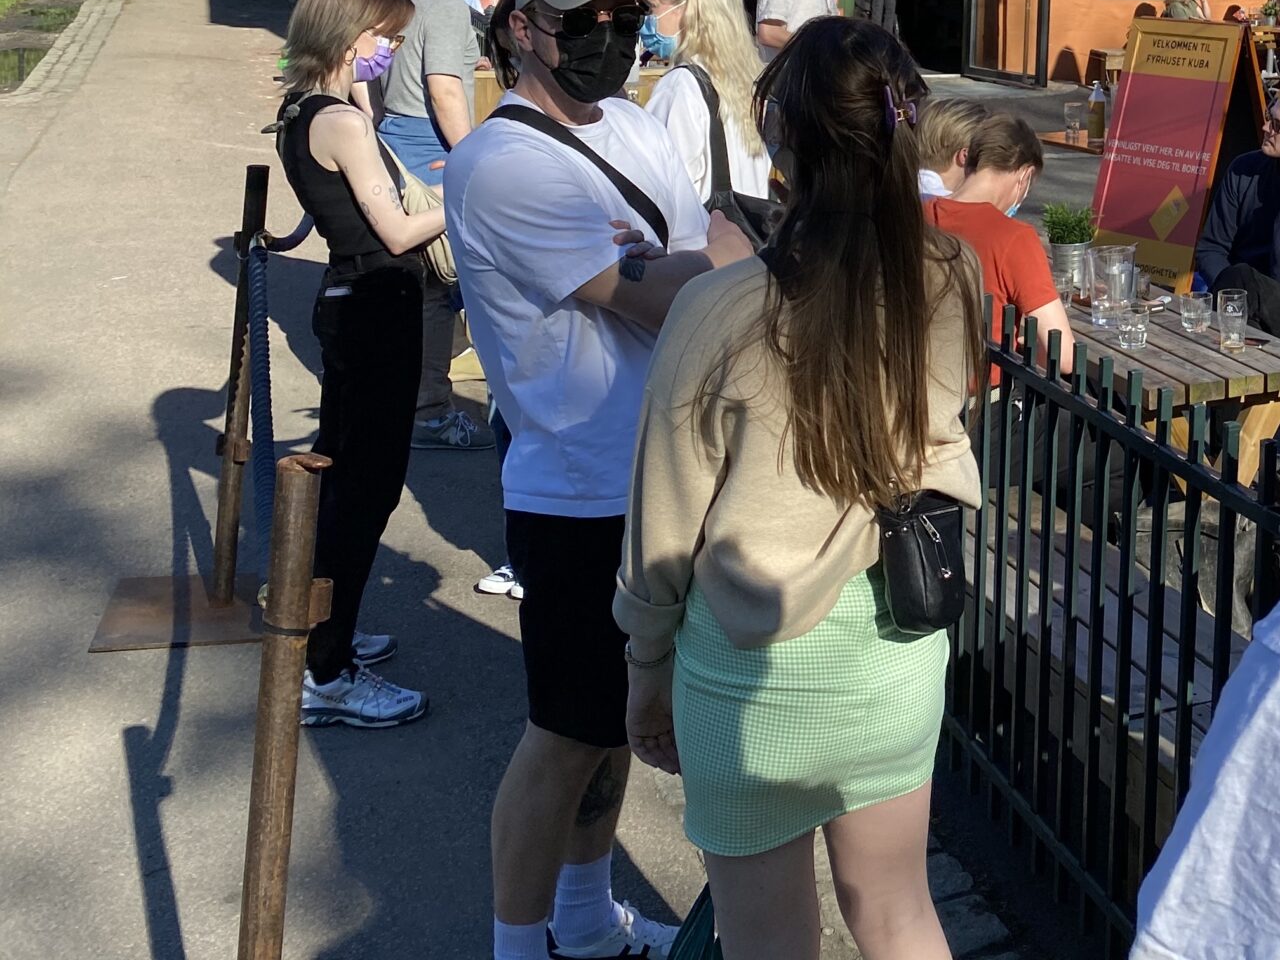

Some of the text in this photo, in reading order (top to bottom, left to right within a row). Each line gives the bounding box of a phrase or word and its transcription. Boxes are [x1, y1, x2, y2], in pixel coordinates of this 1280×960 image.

[1152, 38, 1211, 53] VELKOMMEN TIL
[1146, 54, 1209, 69] FYRHUSET KUBA
[1142, 144, 1159, 153] VENT
